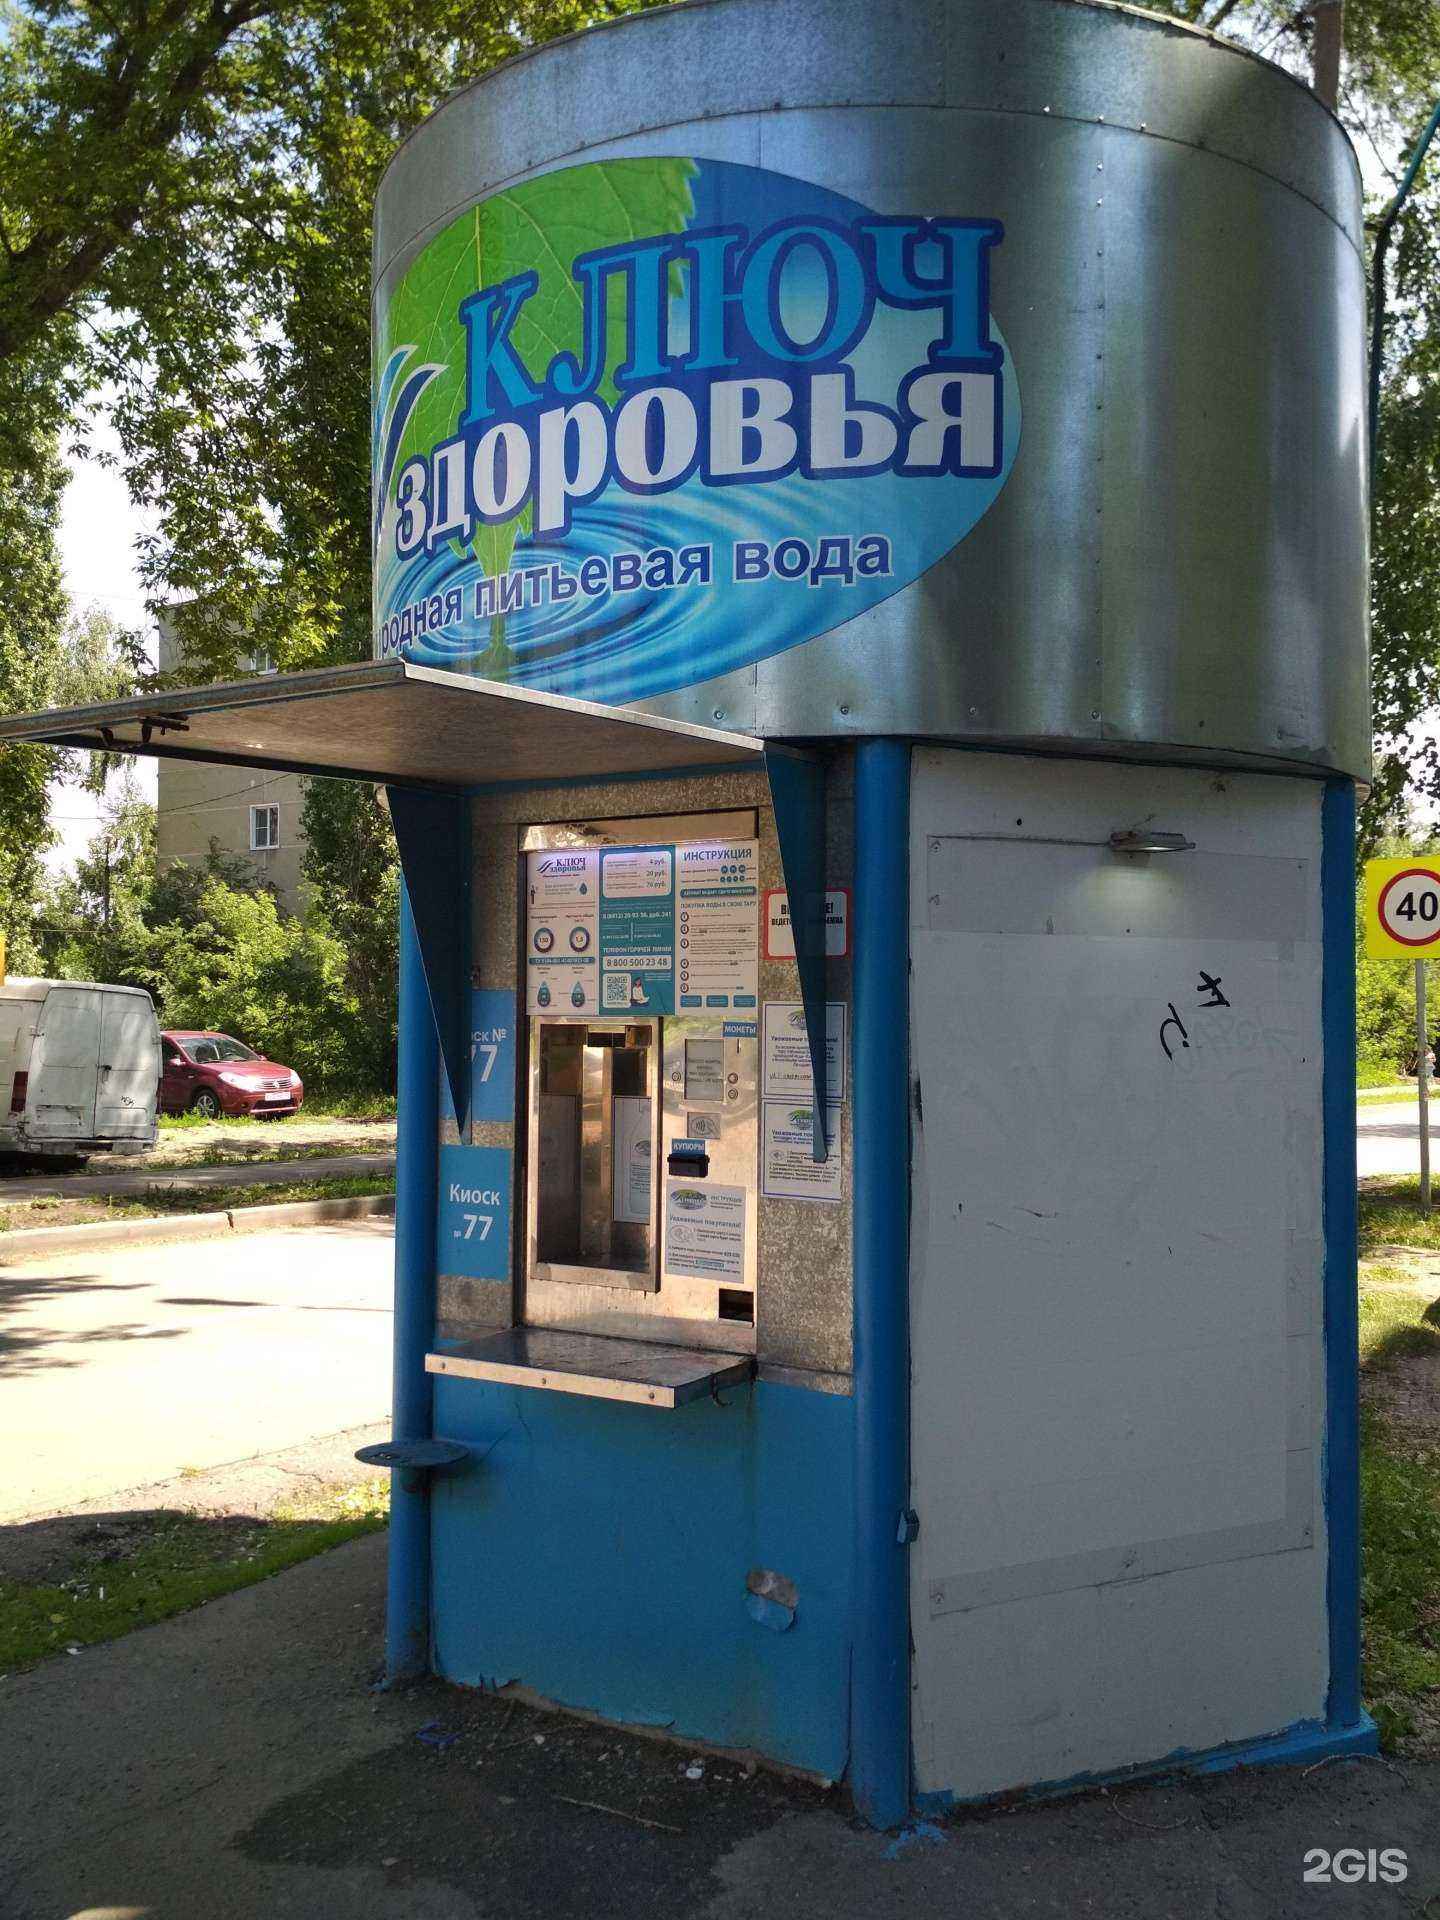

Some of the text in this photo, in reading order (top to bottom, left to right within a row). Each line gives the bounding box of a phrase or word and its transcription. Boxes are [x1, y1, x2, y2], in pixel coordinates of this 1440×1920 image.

[462, 221, 1001, 428] КЛЮЧ
[377, 536, 891, 659] родная питьевая вода
[684, 849, 752, 861] ИНСТРУКЦИЯ
[1396, 891, 1439, 922] 40
[657, 958, 667, 966] 48
[724, 1024, 756, 1033] МОНЕТЫ
[450, 1183, 500, 1206] Киоск
[463, 1214, 493, 1241] 77
